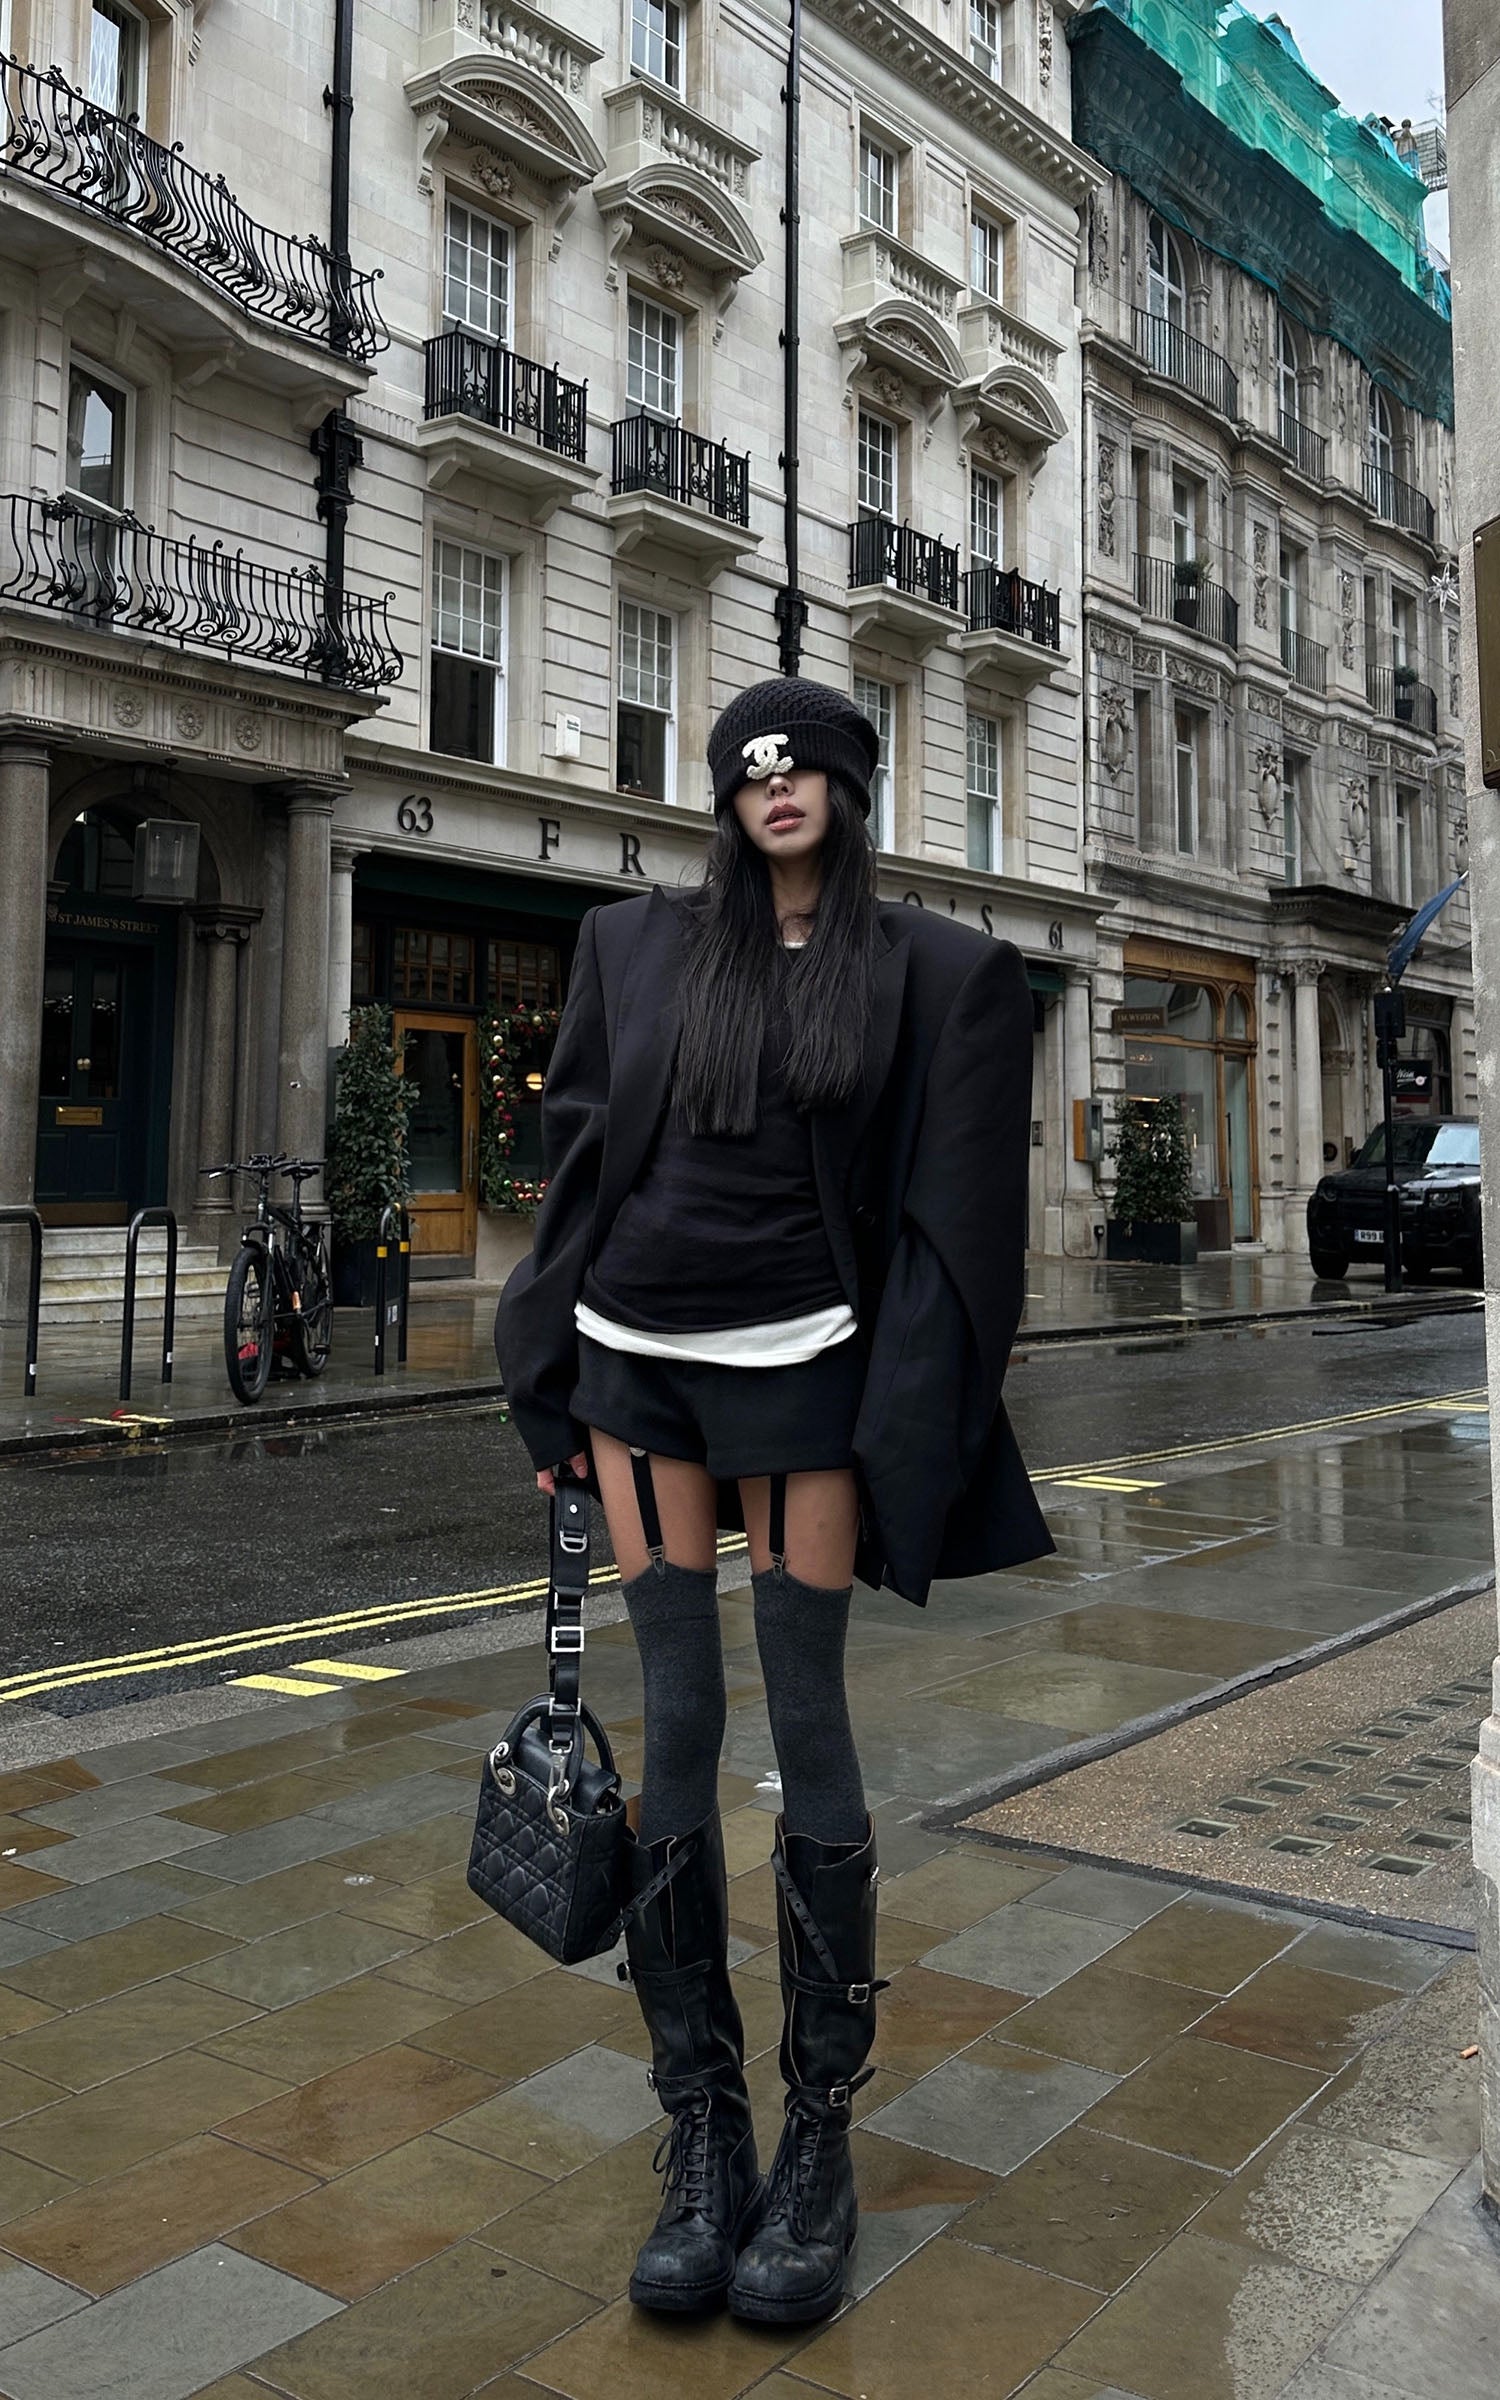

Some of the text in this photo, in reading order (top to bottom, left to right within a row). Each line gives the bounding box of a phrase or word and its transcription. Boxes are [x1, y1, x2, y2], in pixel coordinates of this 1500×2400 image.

[397, 794, 434, 833] 63
[73, 915, 119, 930] JAMES'S
[119, 921, 160, 935] STREET
[1048, 919, 1064, 950] 61
